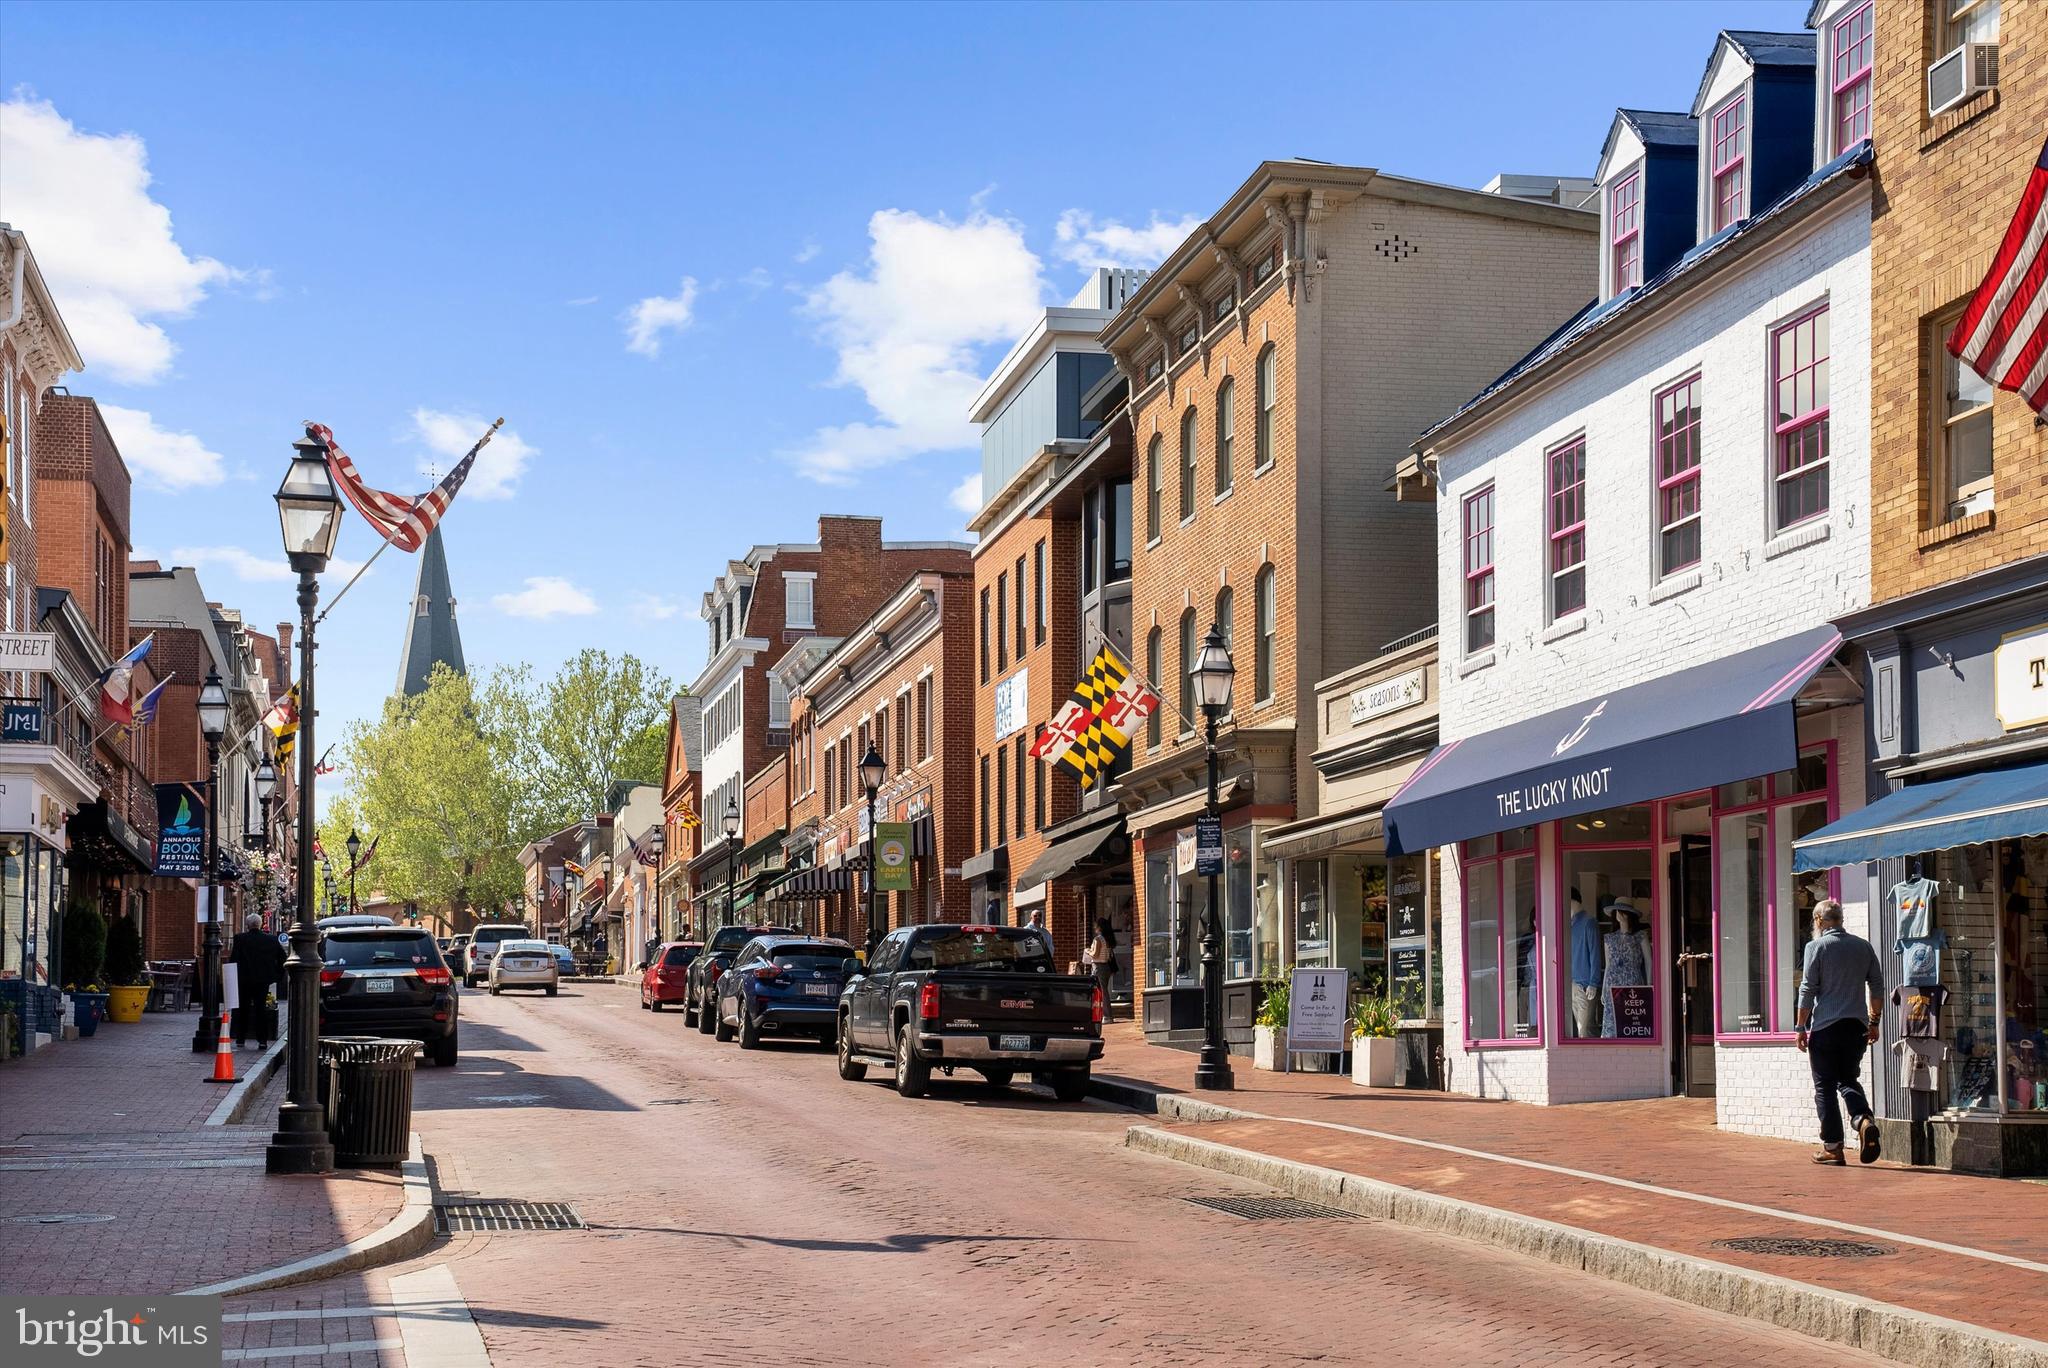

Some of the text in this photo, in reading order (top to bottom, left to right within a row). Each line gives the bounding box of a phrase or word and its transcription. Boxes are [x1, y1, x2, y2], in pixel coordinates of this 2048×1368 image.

[1370, 684, 1400, 709] seasons
[1497, 767, 1609, 817] THE LUCKY KNOT
[162, 843, 200, 854] BOOK
[1000, 1000, 1034, 1009] GMC
[1623, 1026, 1651, 1036] OPEN
